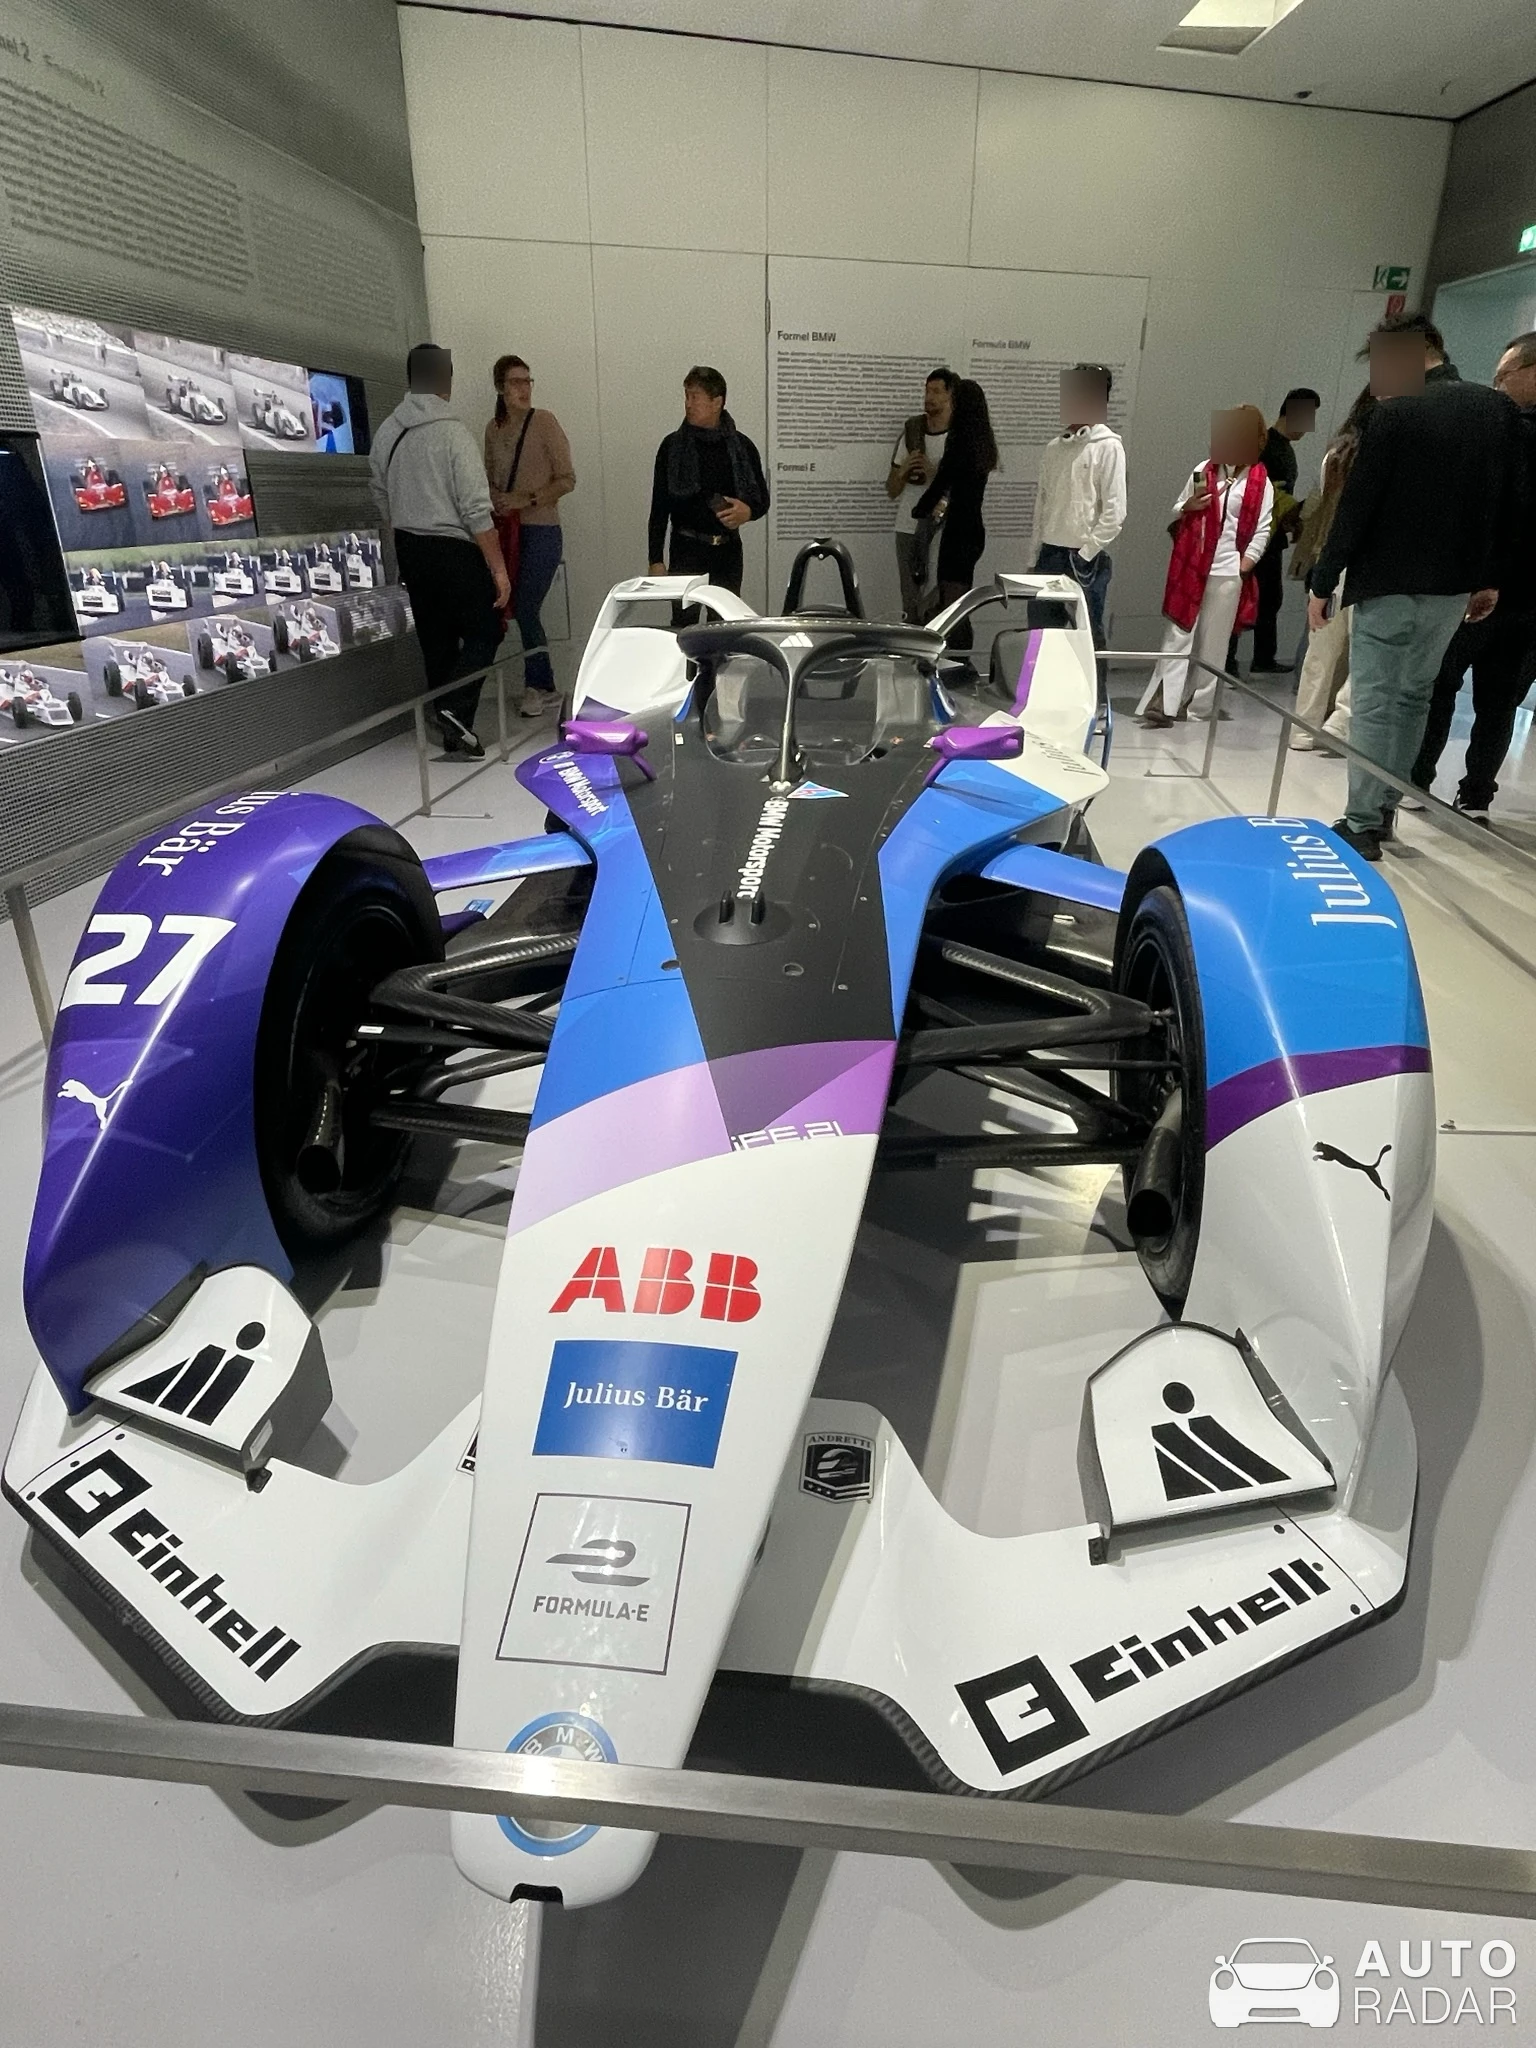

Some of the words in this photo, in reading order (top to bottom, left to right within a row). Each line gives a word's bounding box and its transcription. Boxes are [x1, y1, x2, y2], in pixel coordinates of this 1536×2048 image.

[777, 330, 809, 342] Formel
[811, 331, 837, 342] BMW
[1008, 340, 1031, 350] BMW
[777, 462, 808, 472] Formel
[809, 463, 816, 472] E
[567, 780, 610, 817] Motorsport
[758, 800, 790, 828] BMW
[137, 820, 247, 877] Bär
[736, 827, 783, 899] Motorsport
[1280, 834, 1398, 929] Julius
[59, 913, 237, 1012] 27
[548, 1247, 762, 1323] ABB
[564, 1382, 645, 1408] Julius
[655, 1386, 709, 1413] Bär
[808, 1434, 872, 1449] ANDRETTI
[524, 1727, 603, 1762] BMW
